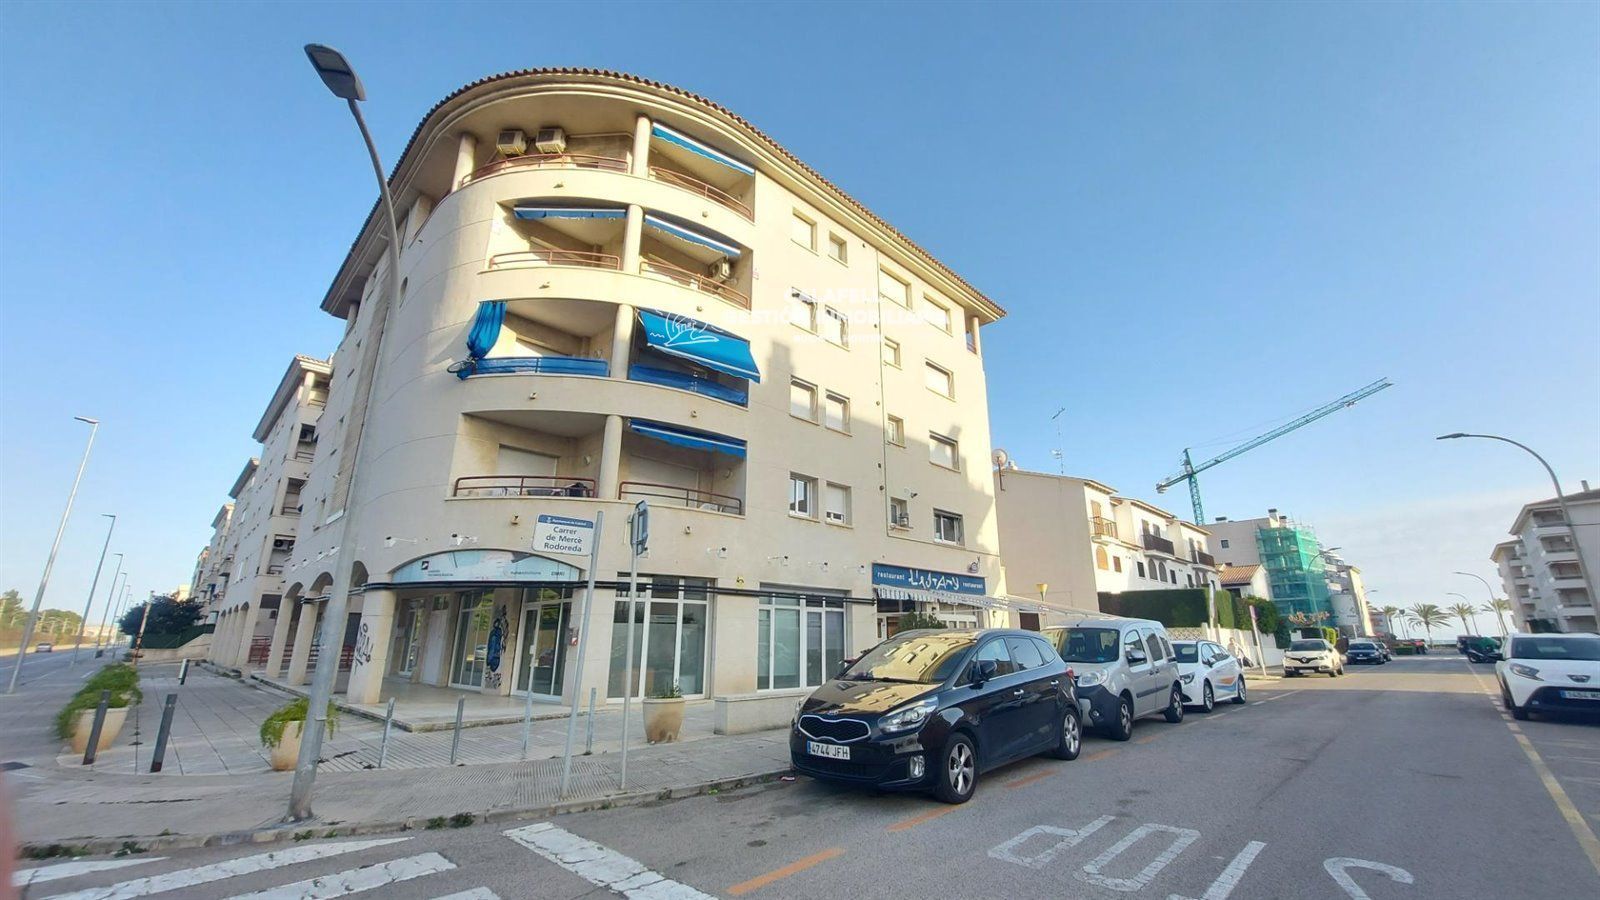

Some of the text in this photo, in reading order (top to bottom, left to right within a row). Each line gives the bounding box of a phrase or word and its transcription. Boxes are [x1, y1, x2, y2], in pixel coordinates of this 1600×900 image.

[553, 526, 577, 535] Carrer
[546, 534, 556, 542] de
[544, 542, 582, 552] Rodoreda
[877, 571, 905, 581] restaurant
[811, 743, 849, 757] 4744 JFH
